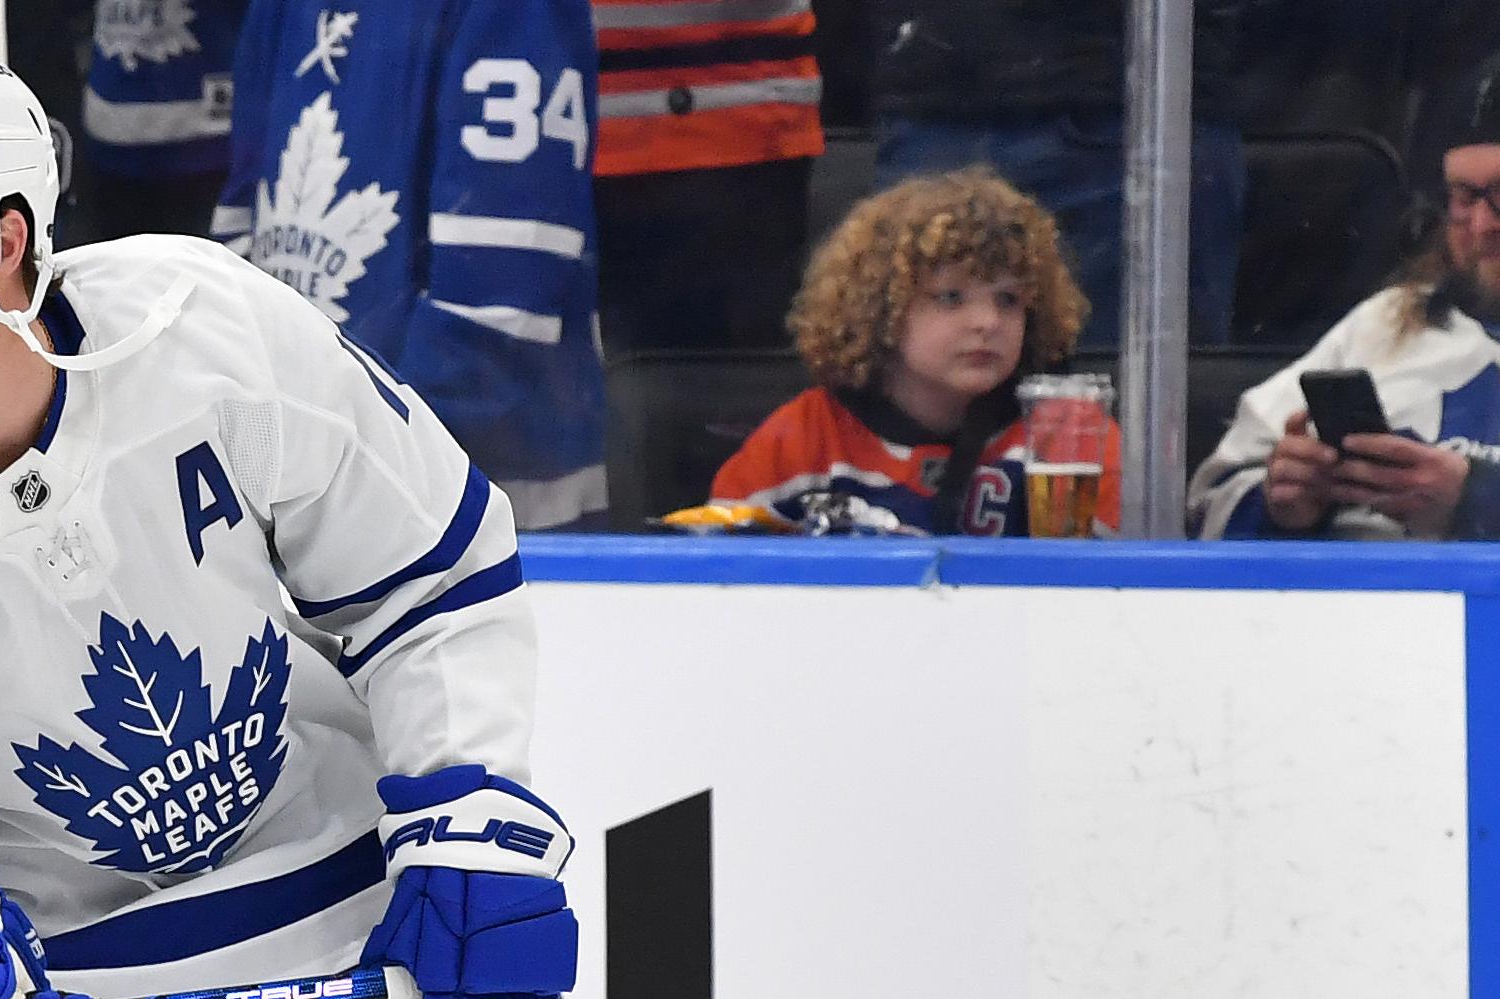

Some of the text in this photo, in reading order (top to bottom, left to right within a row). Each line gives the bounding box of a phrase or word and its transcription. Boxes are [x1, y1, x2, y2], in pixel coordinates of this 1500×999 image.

[462, 58, 590, 171] 34
[177, 440, 245, 567] A
[963, 464, 1013, 537] C
[87, 712, 265, 828] TORONTO
[130, 750, 253, 841] MAPLE
[140, 777, 261, 863] LEAFS
